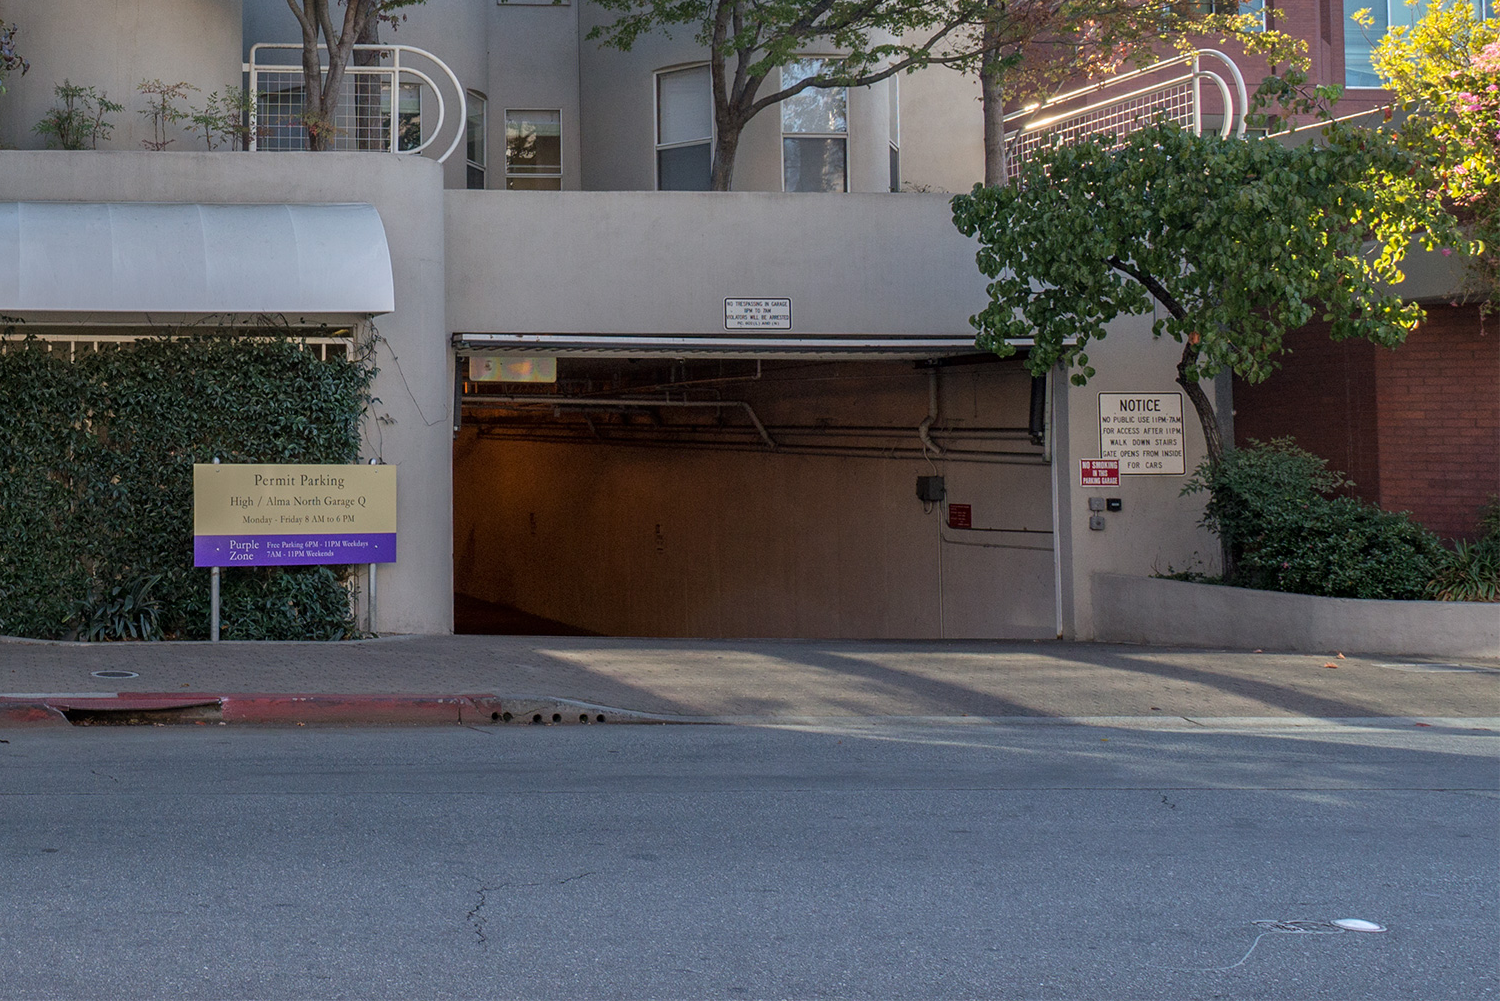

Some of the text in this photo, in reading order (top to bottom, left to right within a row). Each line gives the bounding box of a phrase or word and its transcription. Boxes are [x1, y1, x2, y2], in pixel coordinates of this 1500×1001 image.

[1120, 399, 1161, 412] NOTICE
[1102, 416, 1111, 424] NO
[1113, 416, 1135, 424] PUBLIC
[1138, 416, 1150, 424] USE
[1103, 427, 1115, 435] FOR
[1116, 427, 1140, 435] ACCESS
[1143, 427, 1164, 435] AFTER
[1082, 461, 1118, 469] NO SMOKING
[1127, 461, 1163, 469] FOR CARS
[254, 474, 345, 489] Permit Parking
[230, 496, 366, 509] High / Alma North Garage Q
[242, 515, 273, 526] Monday
[280, 515, 303, 525] Friday
[304, 515, 310, 523] 8
[311, 515, 325, 523] AM
[335, 514, 341, 523] 6
[342, 514, 355, 523] PM
[229, 539, 260, 553] Purple
[266, 541, 280, 549] Free
[282, 541, 304, 550] Parking
[324, 540, 341, 548] 11PM
[342, 540, 369, 549] Weekdays
[229, 551, 254, 561] Zone
[267, 550, 282, 558] 7AM
[288, 550, 305, 558] 11PM
[306, 549, 334, 557] Weekends
